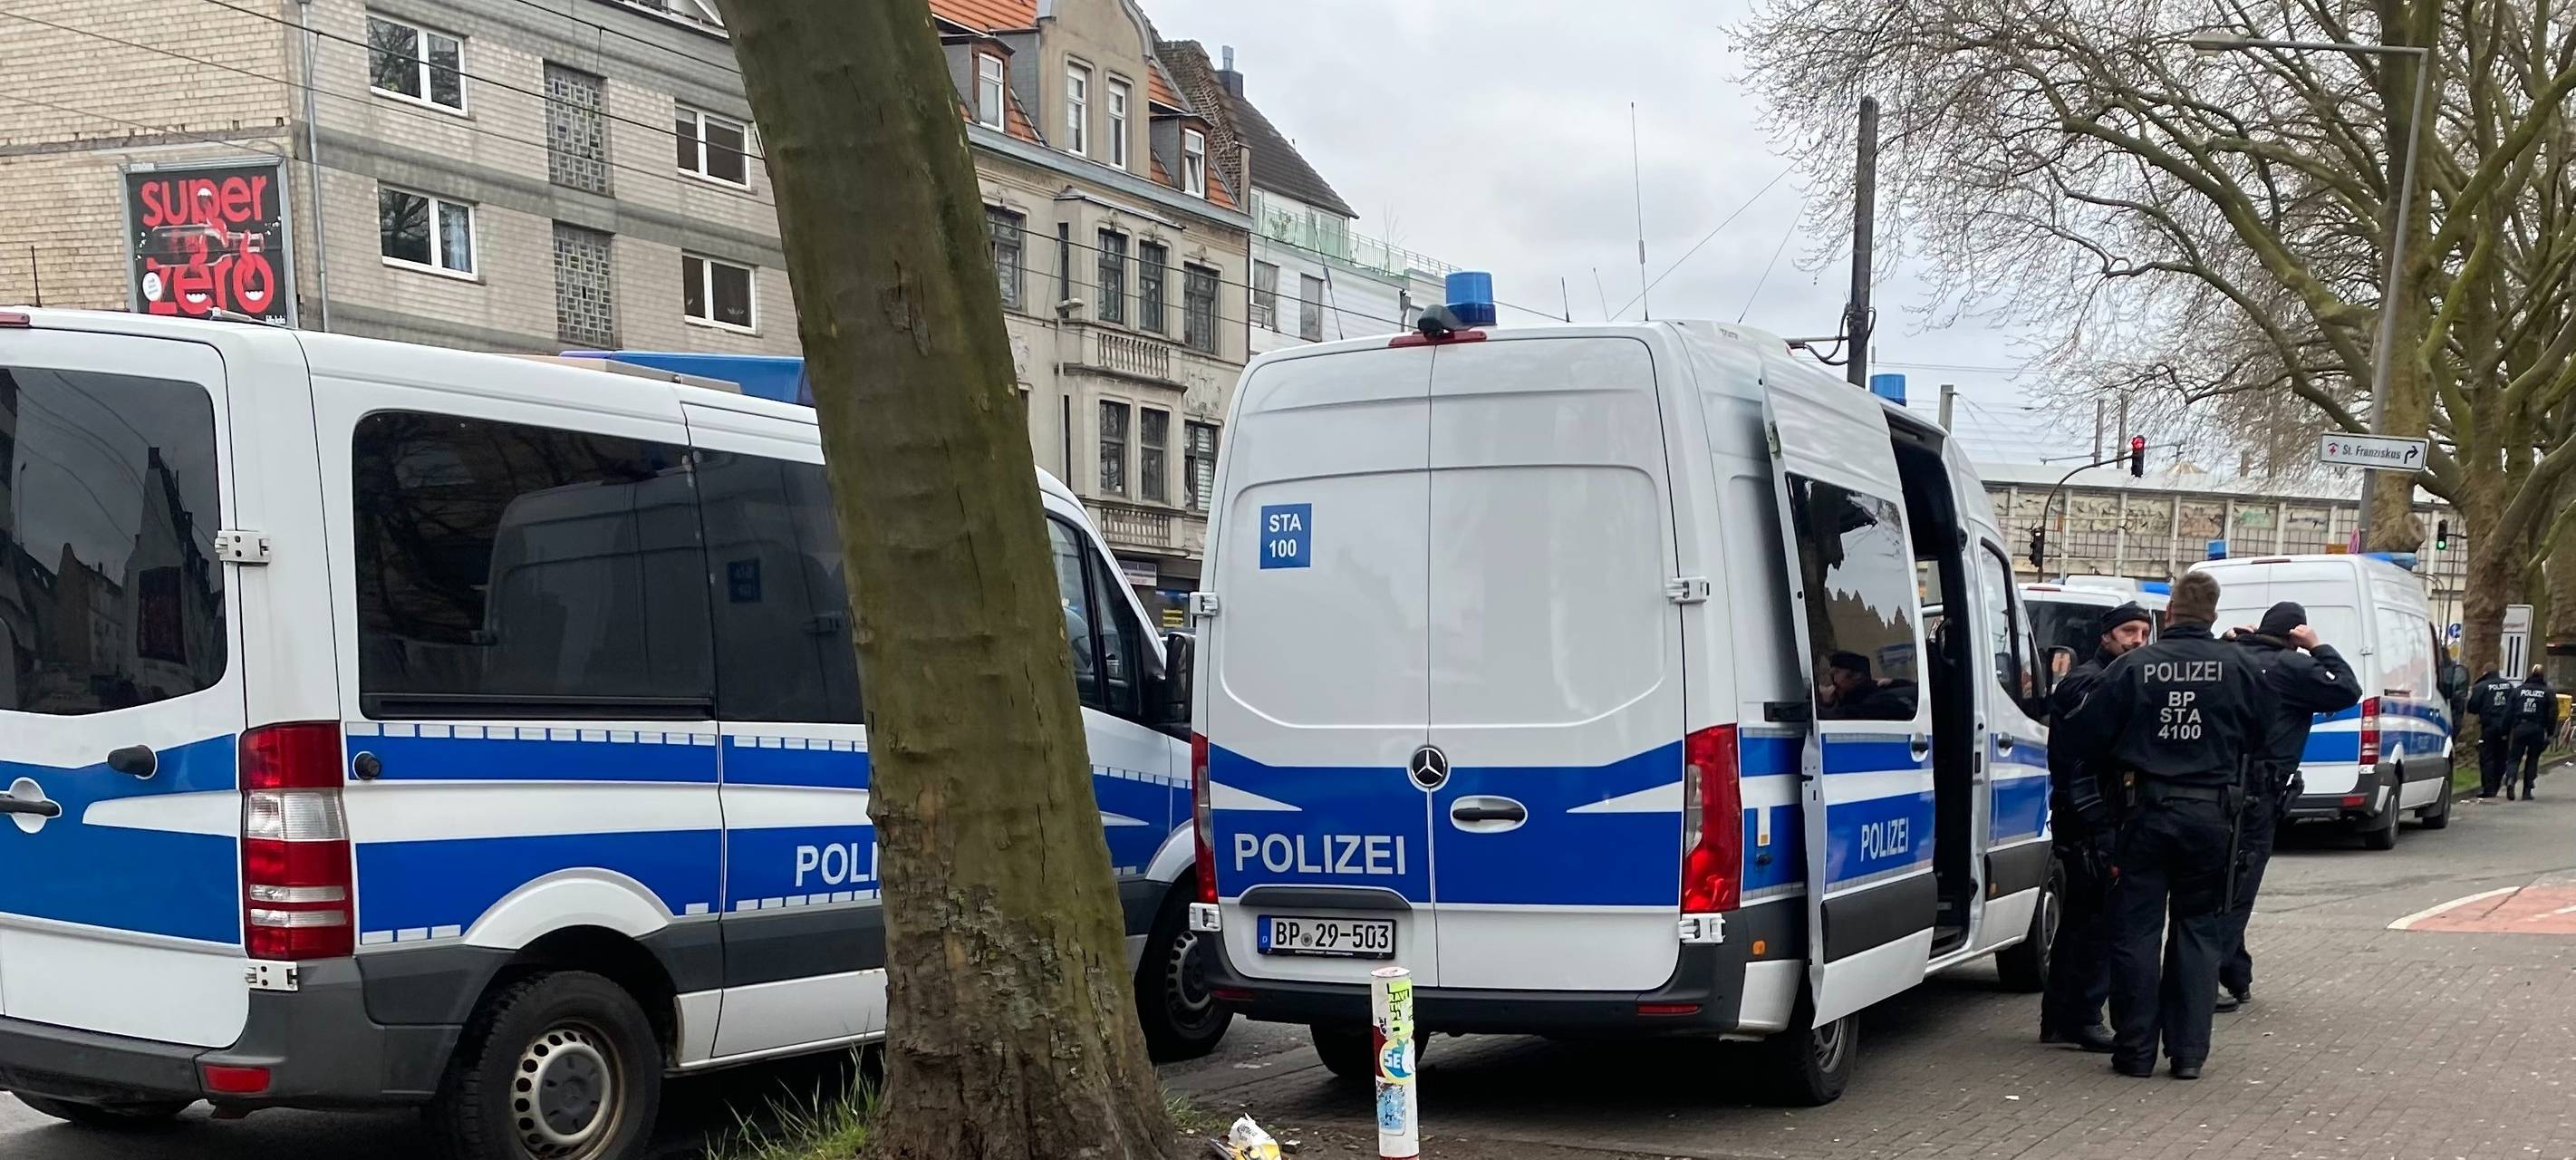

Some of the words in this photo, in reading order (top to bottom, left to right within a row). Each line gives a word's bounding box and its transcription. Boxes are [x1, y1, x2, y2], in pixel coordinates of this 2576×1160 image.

[141, 175, 266, 227] super
[146, 254, 275, 314] zero
[2355, 445, 2401, 459] Franziskus
[1269, 513, 1302, 533] STA
[1269, 538, 1297, 558] 100
[2144, 661, 2223, 683] POLIZEI
[2168, 691, 2195, 707] BP
[2521, 690, 2544, 698] POLIZEI
[2159, 708, 2202, 723] STA
[2157, 724, 2202, 740] 4100
[1860, 817, 1909, 863] POLIZEI
[796, 841, 879, 887] POLI
[1234, 833, 1405, 875] POLIZEI
[1275, 922, 1300, 946] BP
[1316, 923, 1390, 949] 29-503
